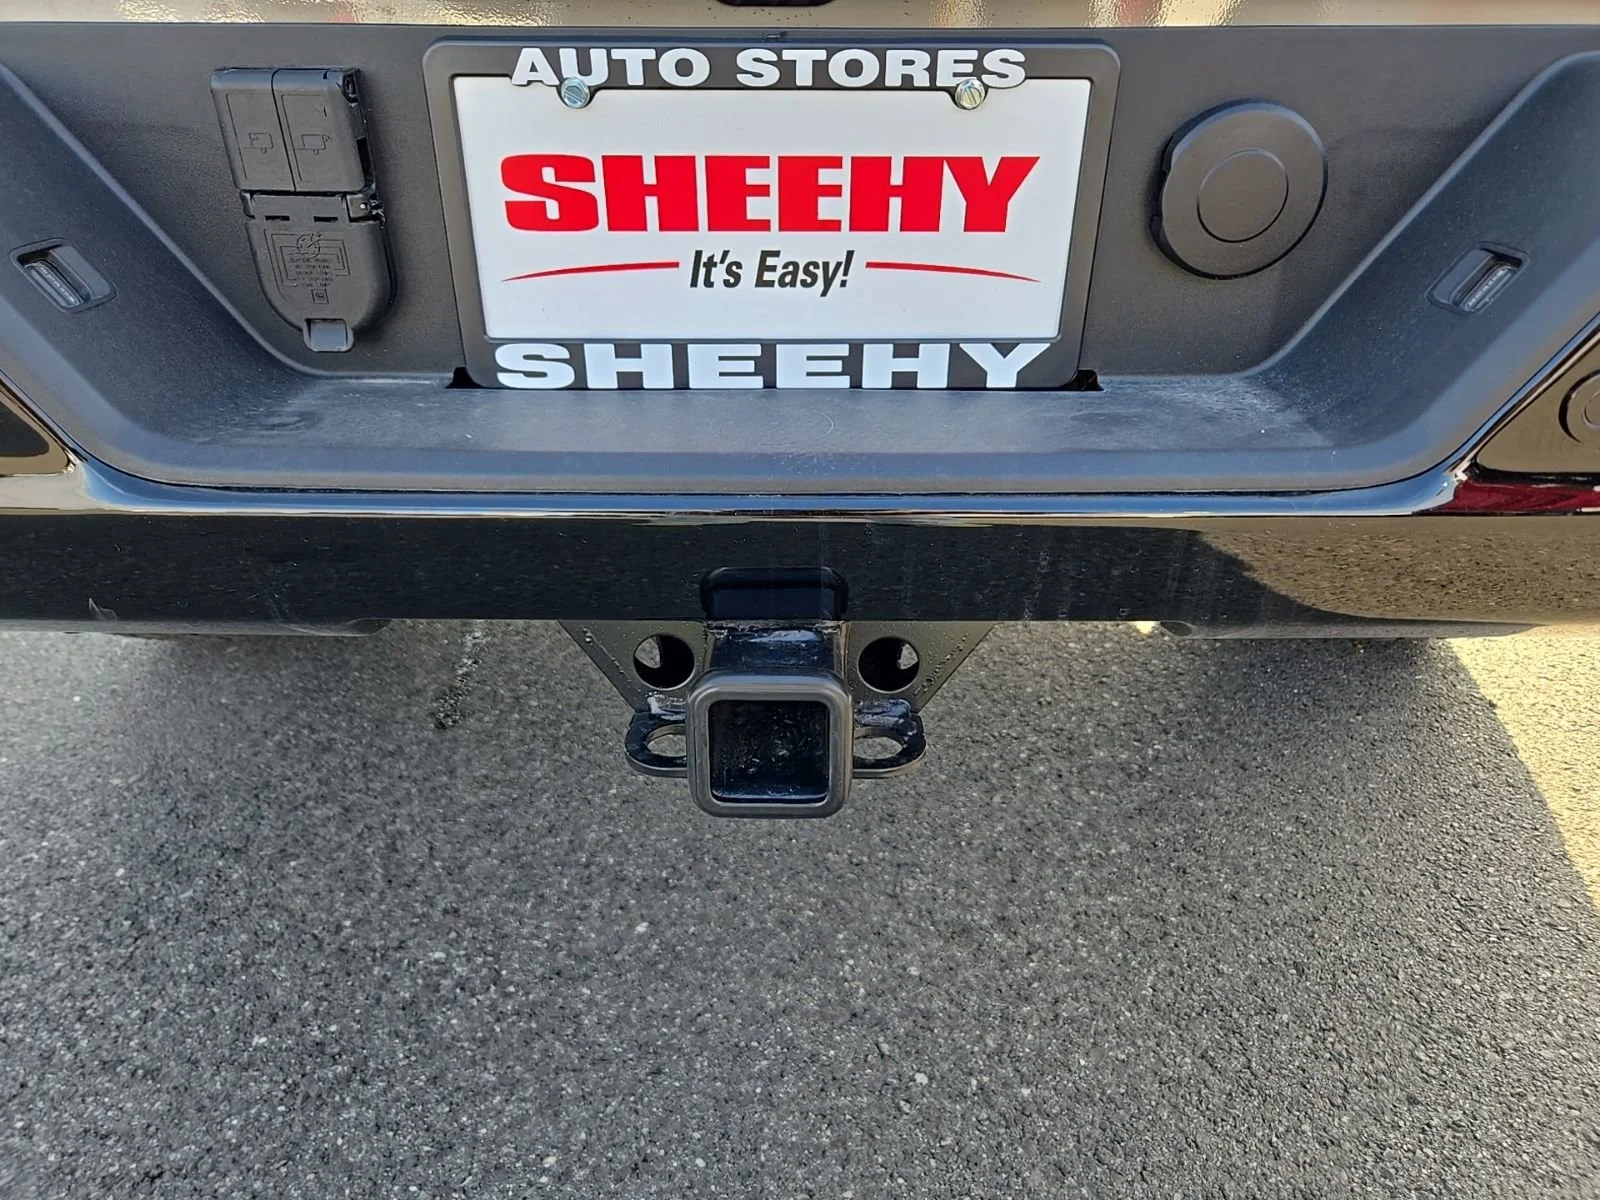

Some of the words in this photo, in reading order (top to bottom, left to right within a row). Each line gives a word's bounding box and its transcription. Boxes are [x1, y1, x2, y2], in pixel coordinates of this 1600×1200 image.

[511, 47, 711, 87] AUTO
[736, 47, 1027, 88] STORES
[500, 154, 1041, 232] SHEEHY
[689, 249, 742, 289] It's
[754, 250, 855, 297] Easy!
[494, 342, 1052, 390] SHEEHY
